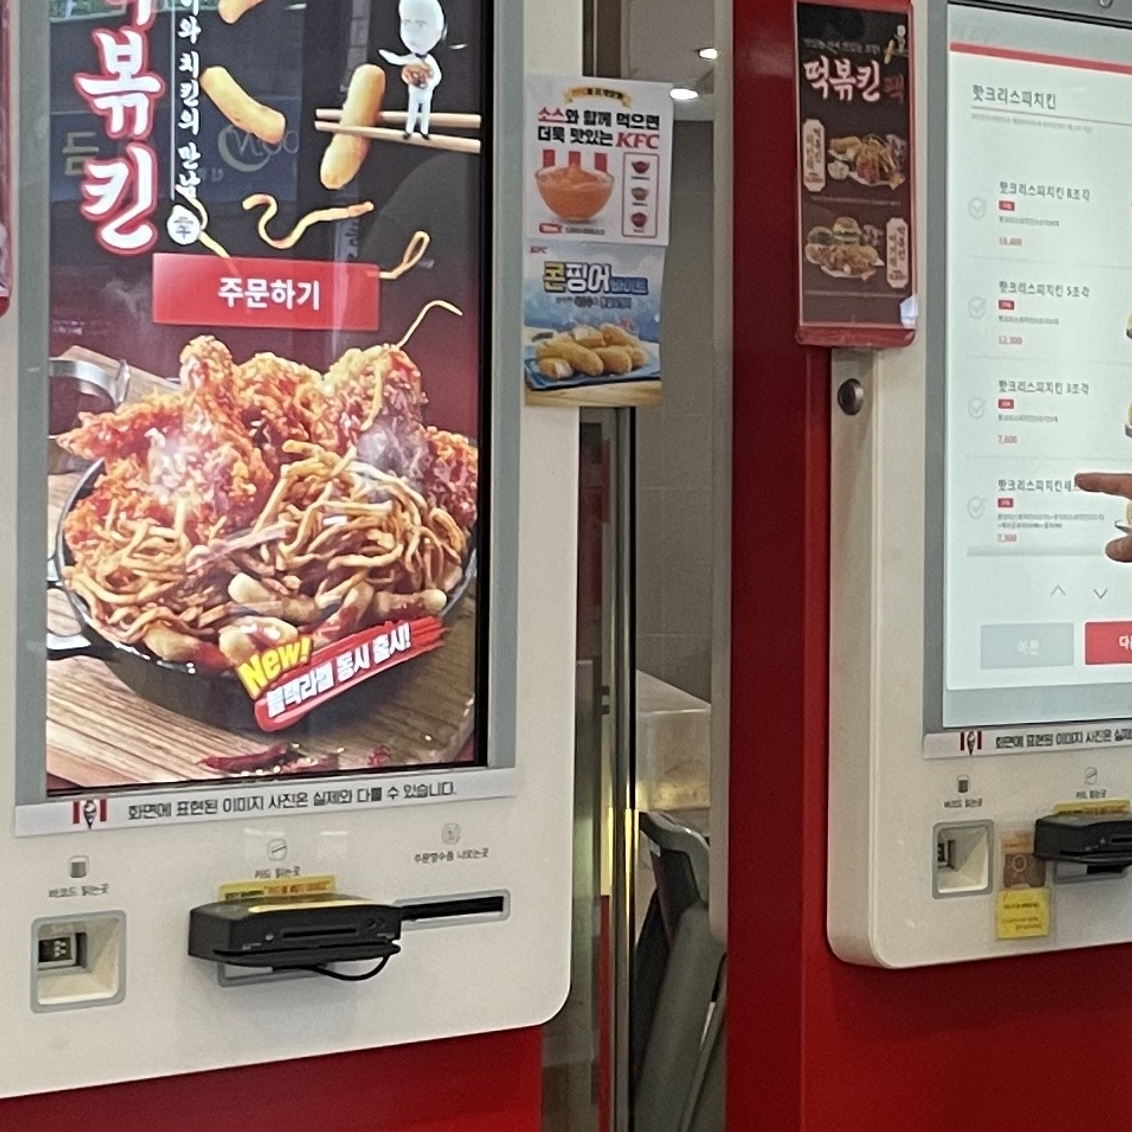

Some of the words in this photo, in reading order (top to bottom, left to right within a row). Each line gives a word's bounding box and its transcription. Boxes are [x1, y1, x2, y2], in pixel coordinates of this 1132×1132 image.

[803, 55, 881, 102] 떡볶킨
[973, 84, 1056, 110] 핫크리스피치킨
[538, 107, 579, 124] 소스와
[584, 110, 612, 127] 함께
[616, 113, 660, 131] 먹으면
[538, 126, 565, 143] 더욱
[570, 129, 613, 147] 맛있는
[615, 132, 660, 150] KFC
[218, 277, 320, 311] 주문하기
[237, 637, 311, 699] New!
[266, 662, 334, 719] 블랙라벨
[336, 643, 371, 682] 동시
[372, 622, 412, 664] 출시!
[128, 803, 172, 821] 화면에
[176, 799, 218, 817] 표현된
[223, 795, 264, 813] 이미지
[268, 791, 309, 809] 사진은
[313, 788, 353, 807] 실제와
[357, 786, 383, 803] 다를
[387, 785, 399, 800] 수
